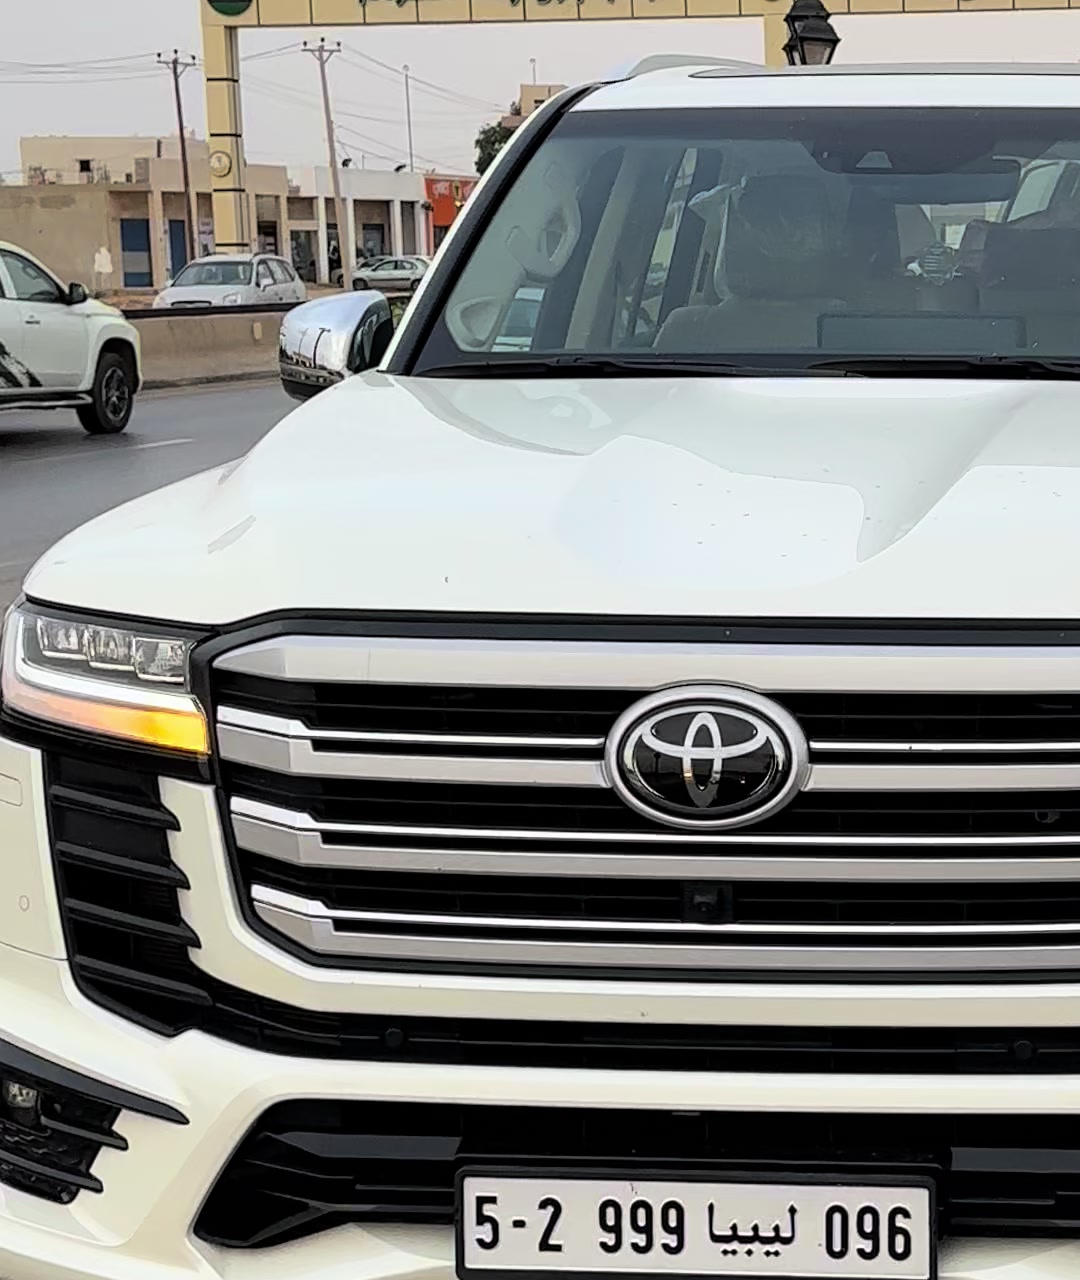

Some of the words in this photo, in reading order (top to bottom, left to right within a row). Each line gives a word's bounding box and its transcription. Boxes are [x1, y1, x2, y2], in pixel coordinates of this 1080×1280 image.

[475, 1195, 563, 1252] 5-2
[598, 1198, 686, 1255] 999
[707, 1202, 798, 1258] ليبيا
[824, 1204, 912, 1261] 096
